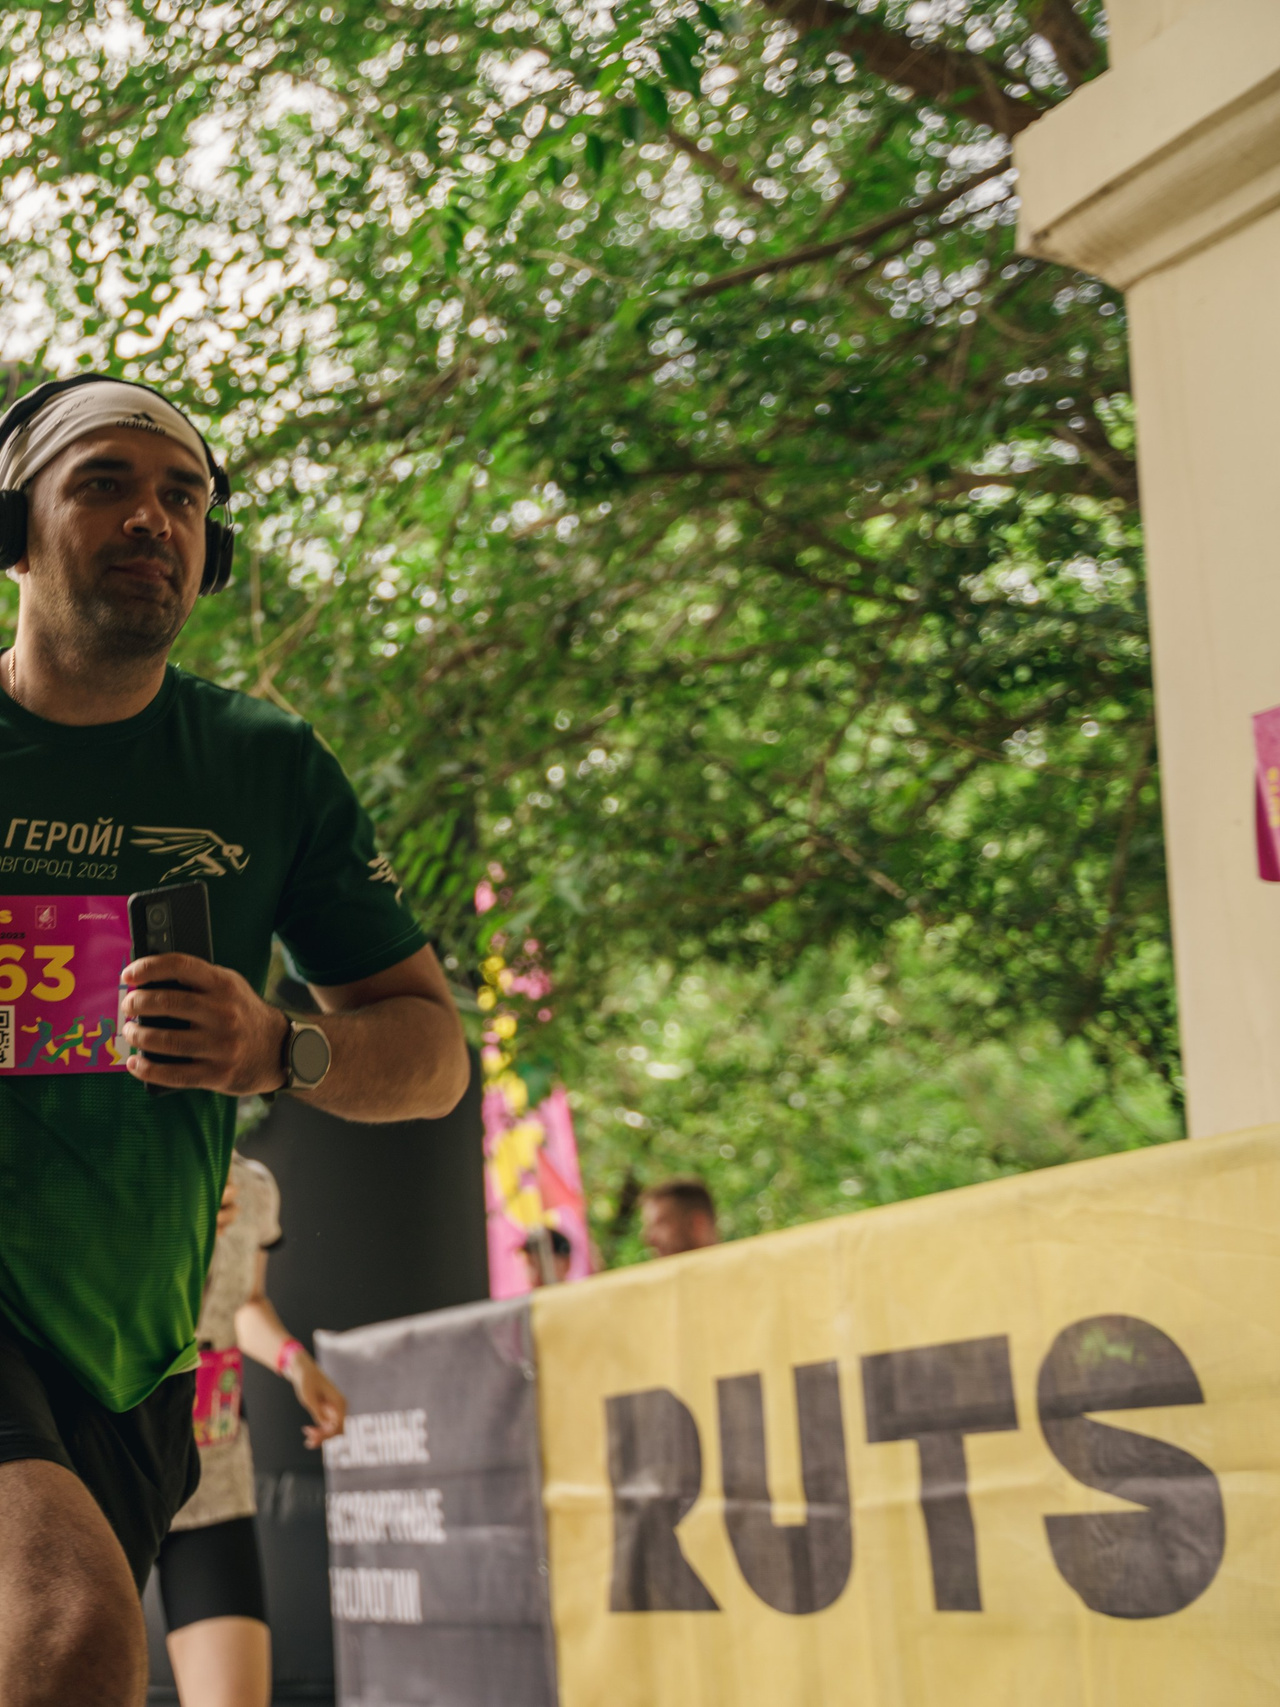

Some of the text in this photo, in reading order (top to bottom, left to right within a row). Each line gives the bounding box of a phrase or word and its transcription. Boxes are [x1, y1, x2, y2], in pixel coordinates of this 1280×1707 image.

[4, 817, 124, 857] ГЕРОЙ!
[76, 861, 119, 881] 2023
[604, 1313, 1227, 1619] RUTS
